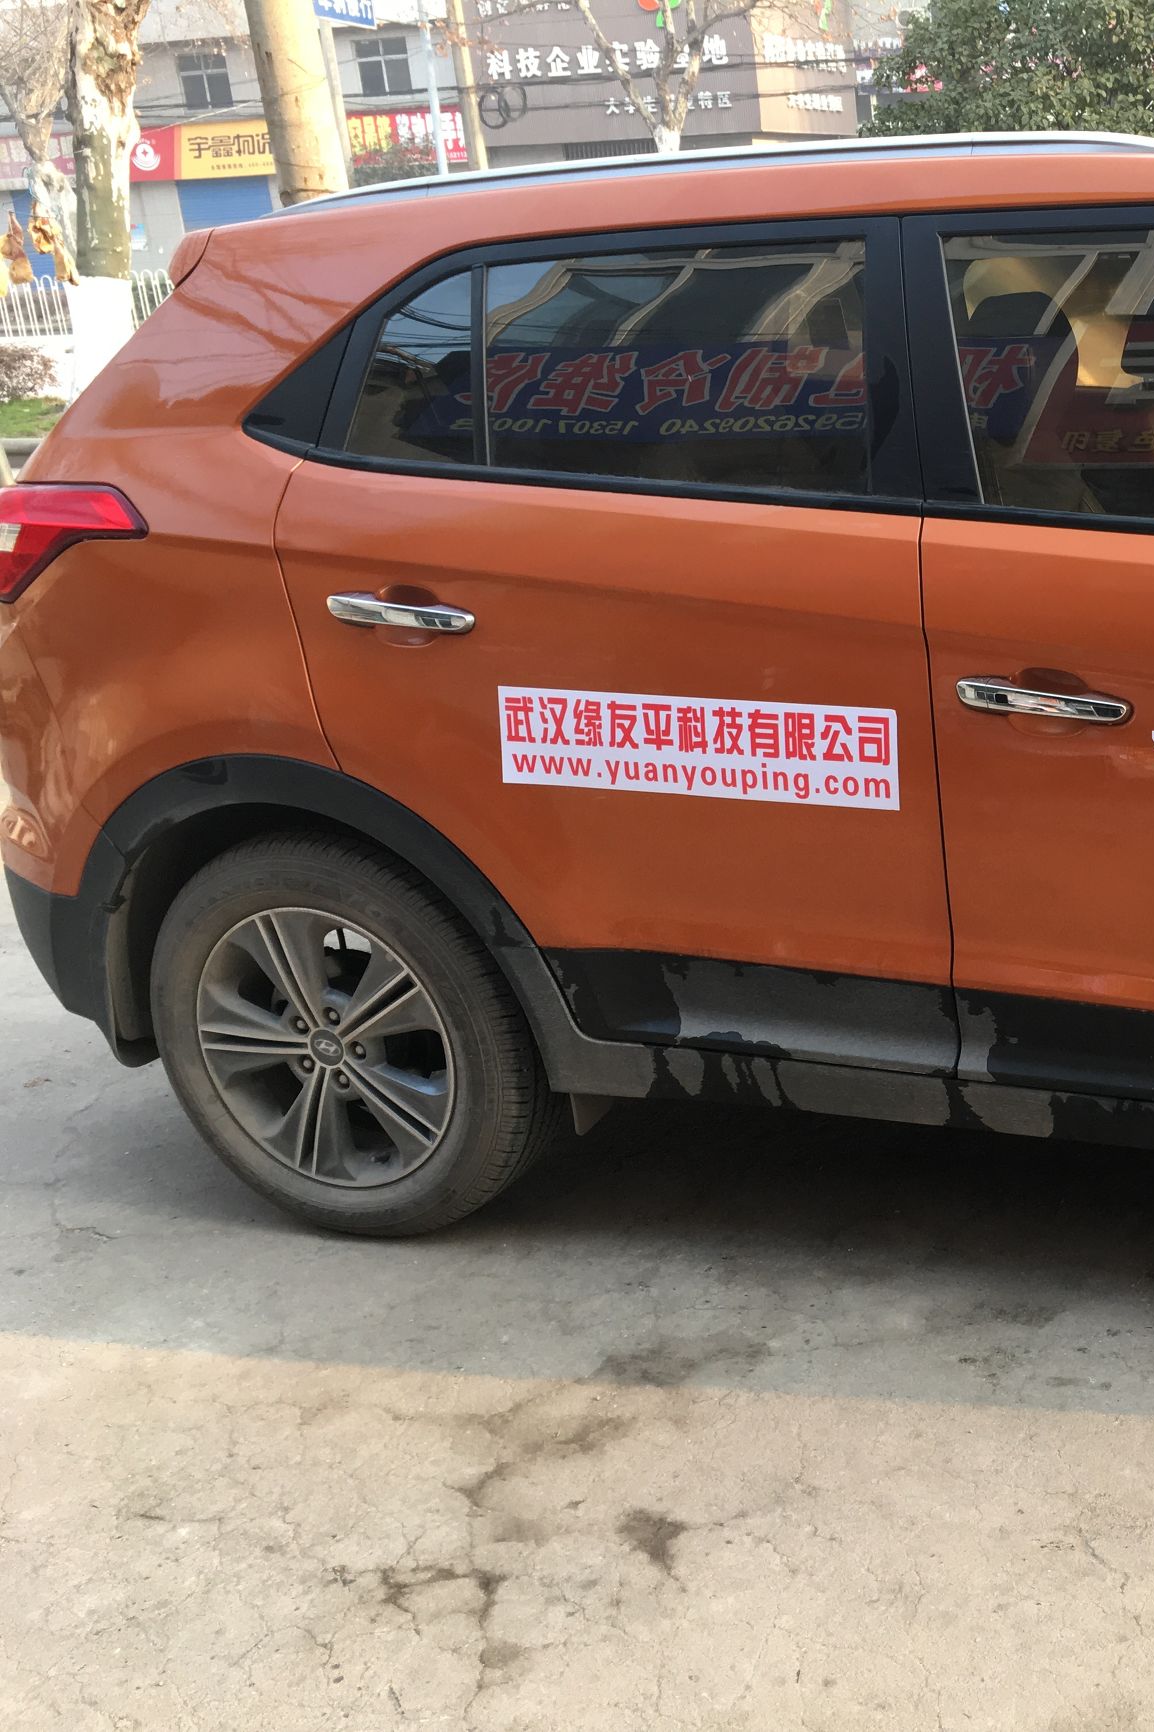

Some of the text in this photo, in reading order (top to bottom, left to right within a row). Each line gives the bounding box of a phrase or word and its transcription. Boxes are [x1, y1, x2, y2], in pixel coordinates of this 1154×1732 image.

[504, 695, 891, 767] 武汉缘友平科技有限公司
[511, 751, 891, 799] www.yuanyouping.com
